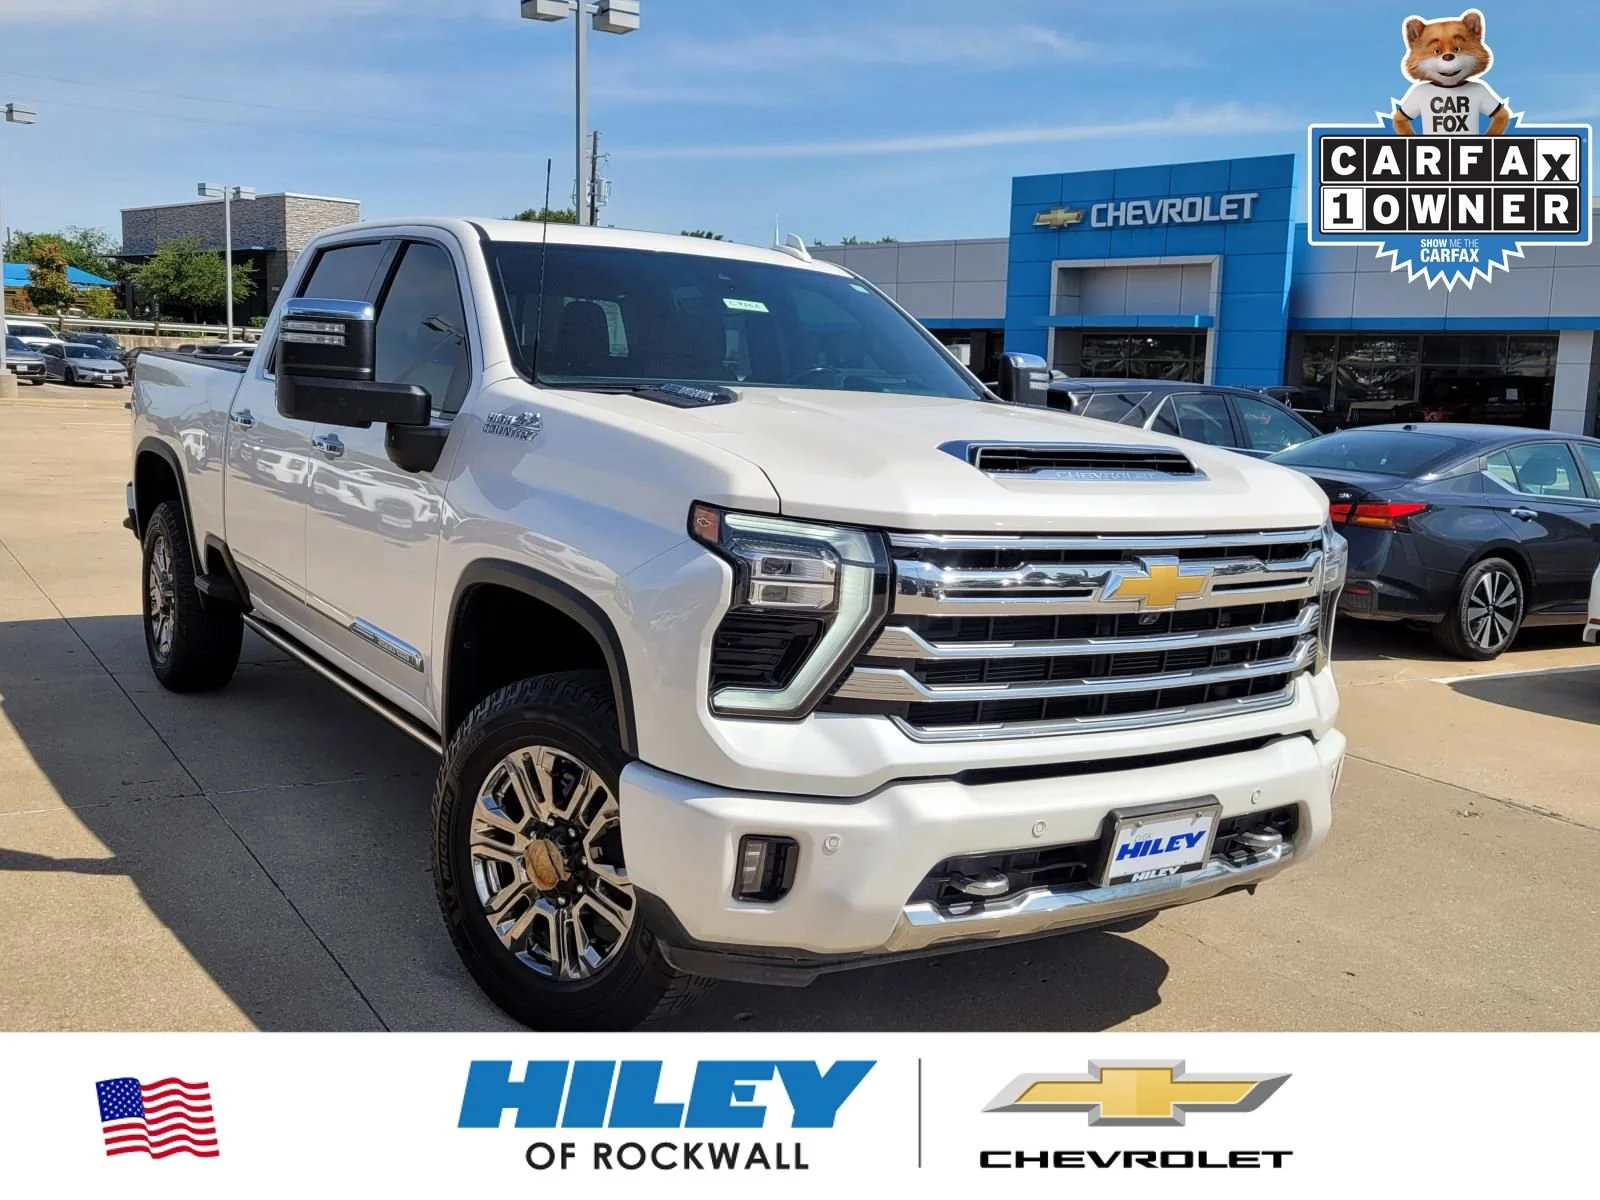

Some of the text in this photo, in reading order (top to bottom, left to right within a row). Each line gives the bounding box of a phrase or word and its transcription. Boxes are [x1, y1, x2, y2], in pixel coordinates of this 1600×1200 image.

[1090, 192, 1259, 228] CHEVROLET
[1115, 830, 1207, 862] HILEY
[1131, 865, 1181, 883] HILEY
